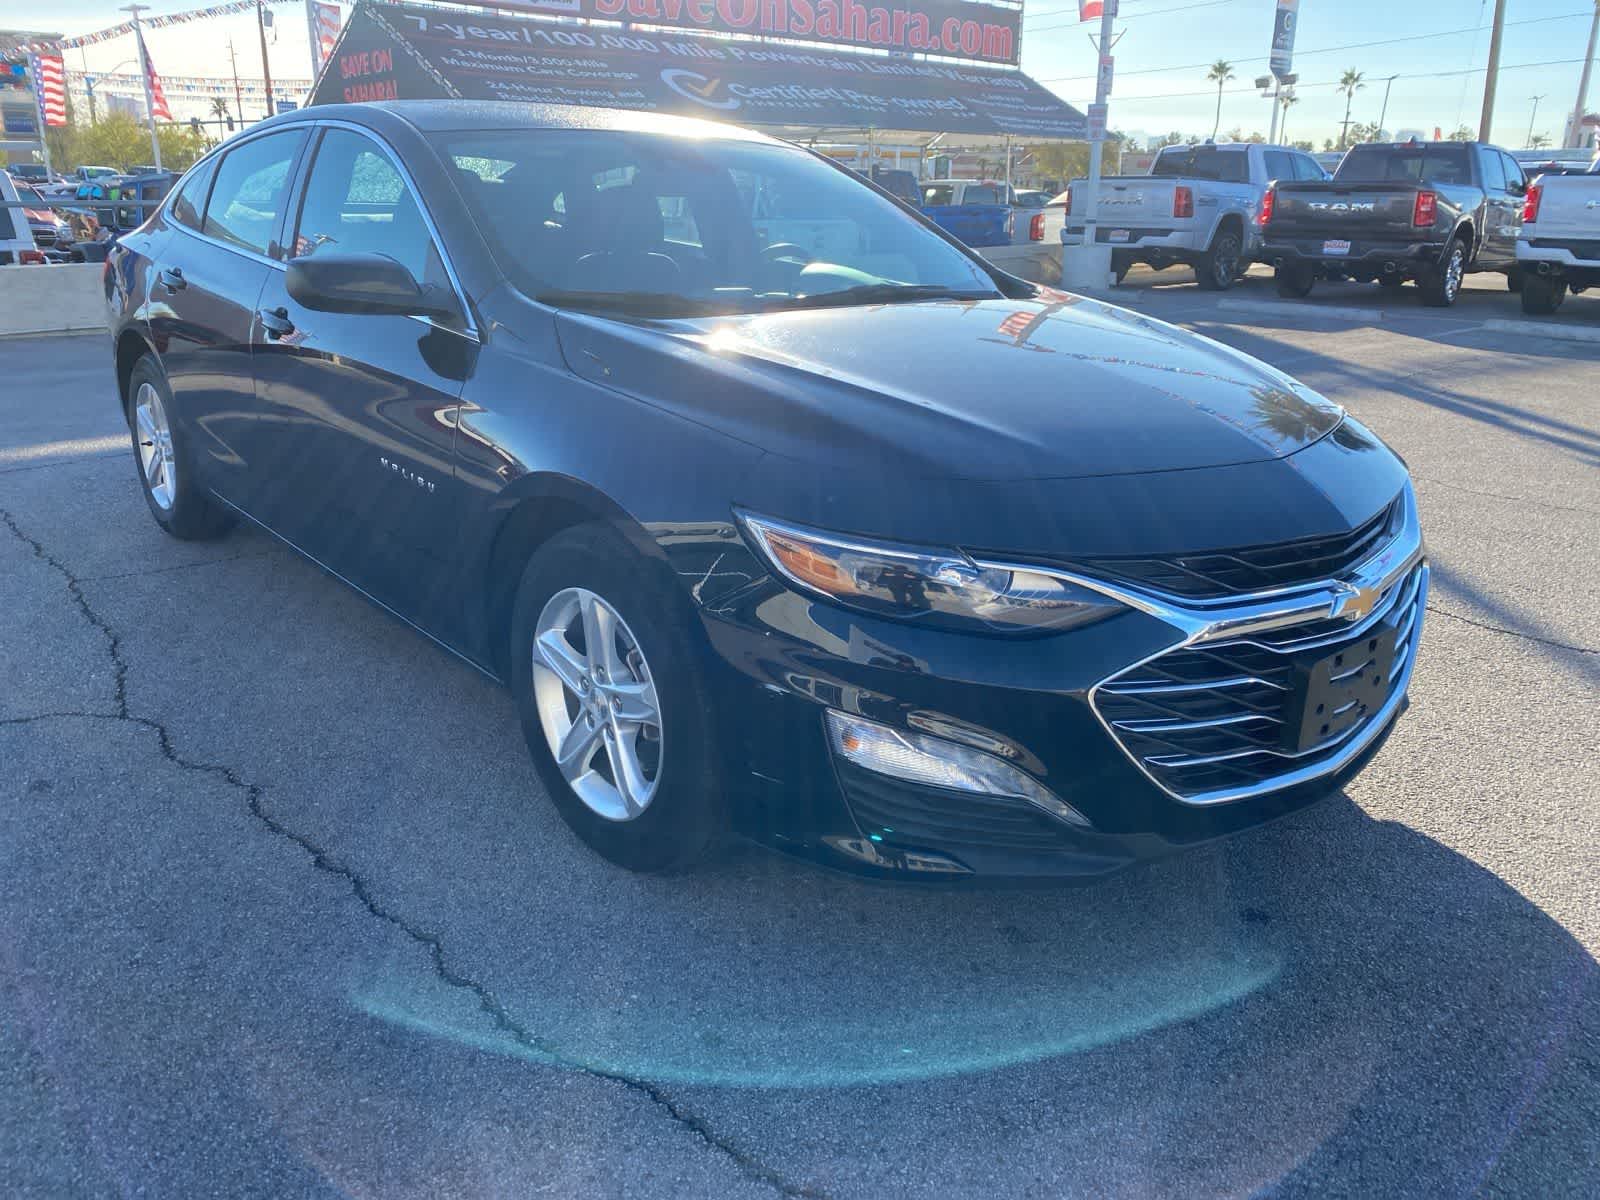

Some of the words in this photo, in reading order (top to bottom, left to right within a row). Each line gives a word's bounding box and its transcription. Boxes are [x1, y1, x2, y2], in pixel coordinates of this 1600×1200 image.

[340, 52, 369, 79] SAVE
[370, 48, 393, 72] ON
[661, 41, 727, 60] Mile
[728, 46, 863, 72] Powertrain
[728, 83, 842, 101] Certified
[1308, 201, 1375, 214] RAM
[380, 457, 435, 492] MALIBU
